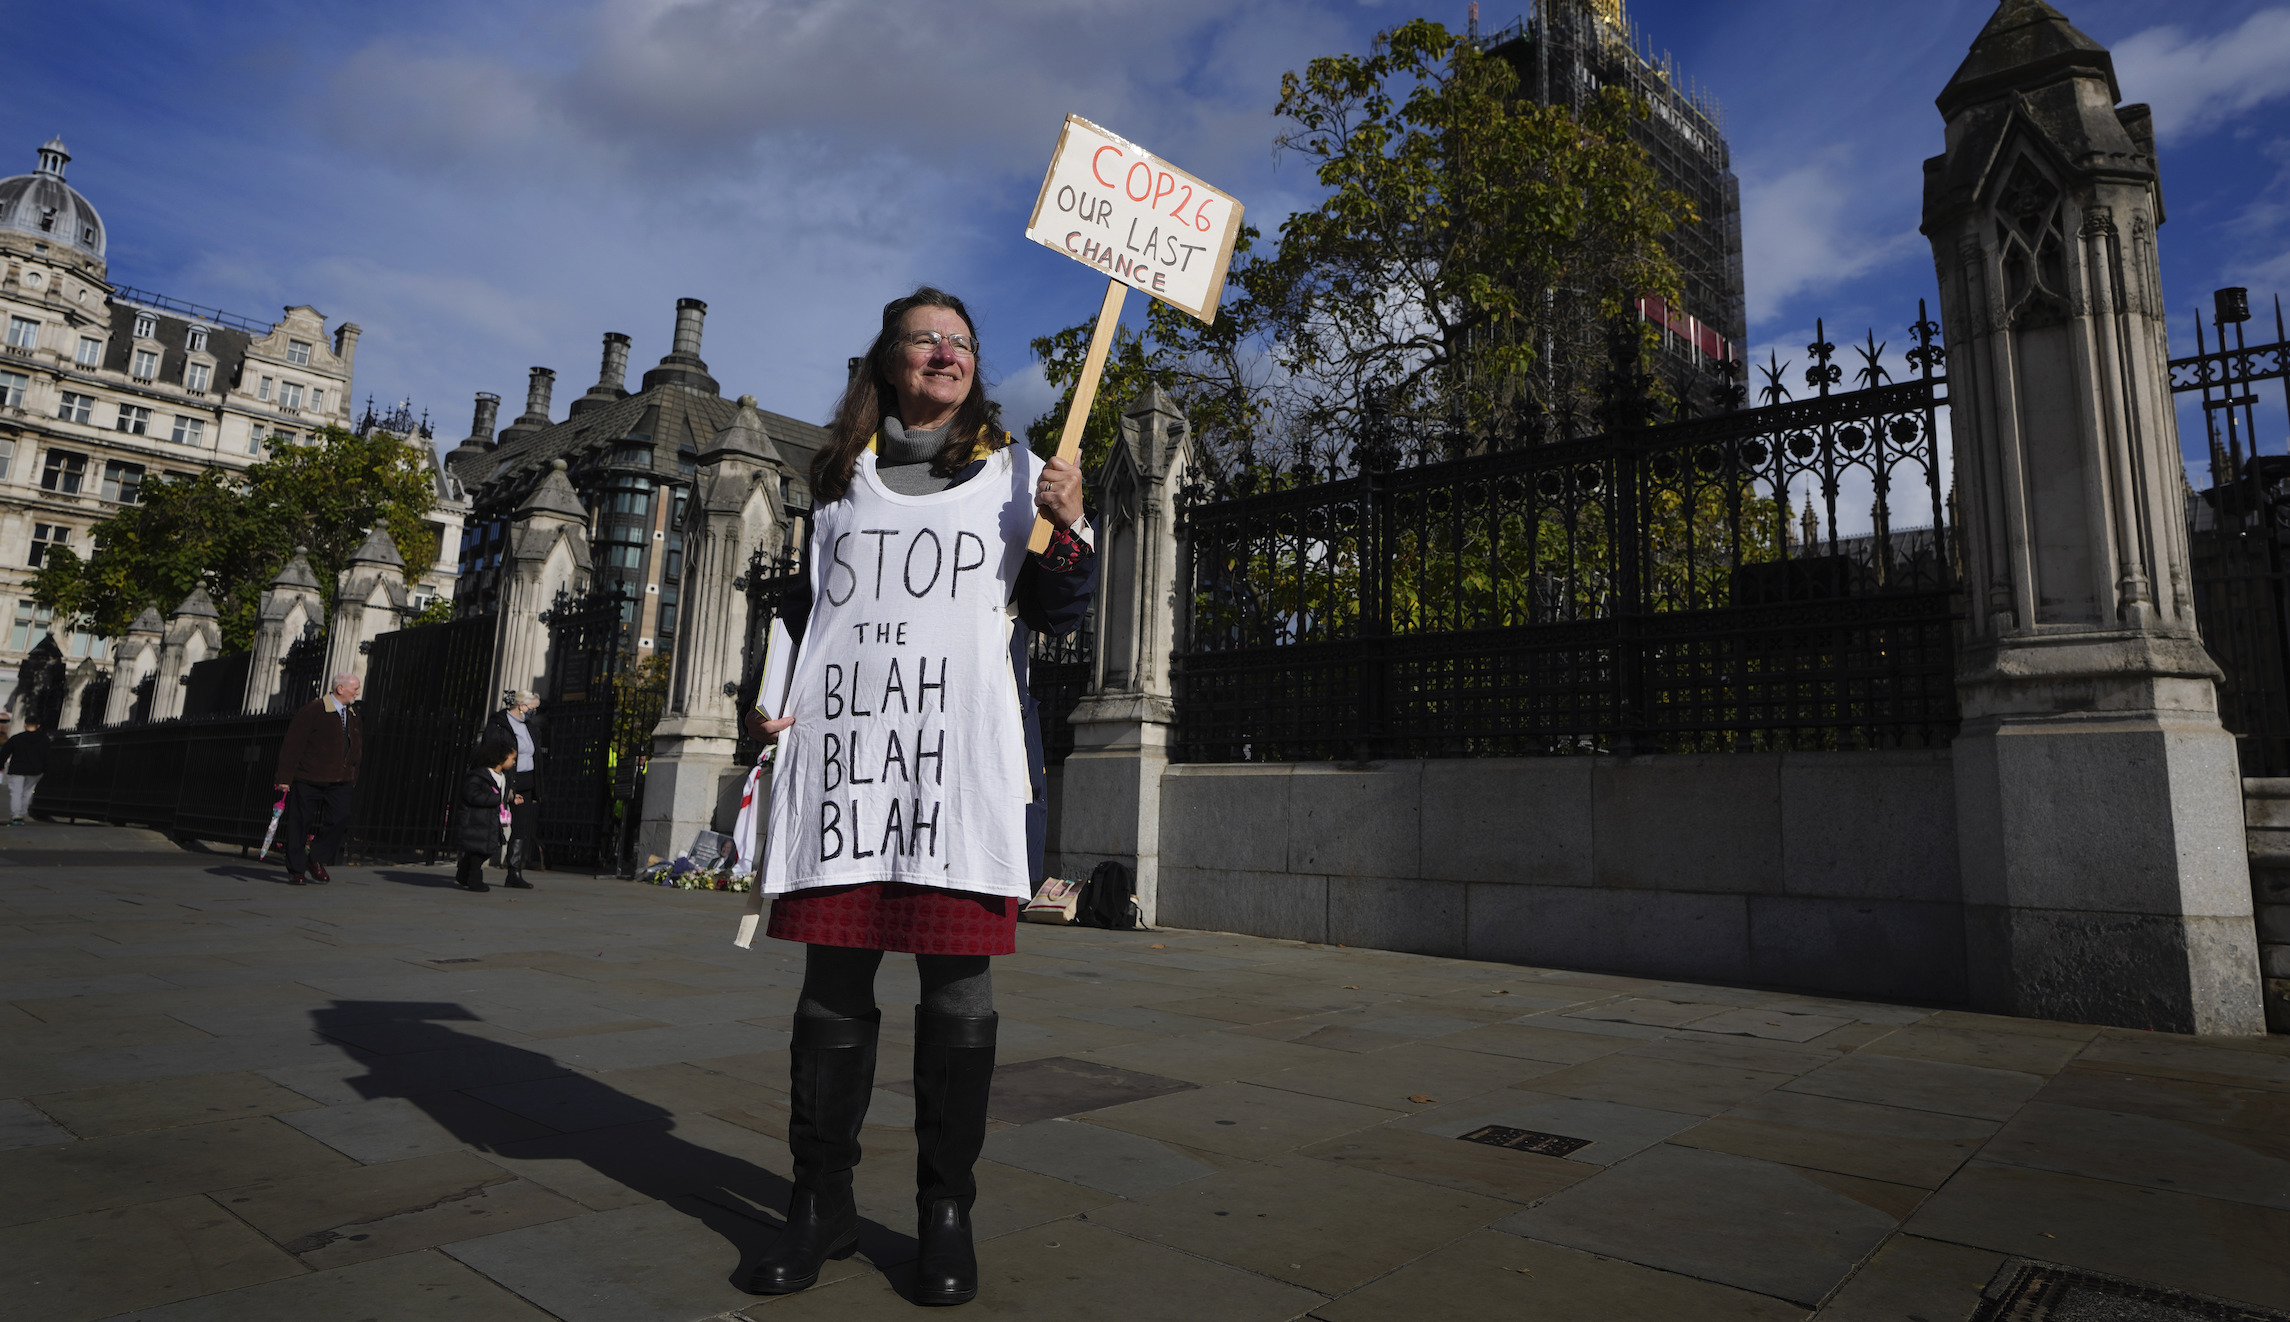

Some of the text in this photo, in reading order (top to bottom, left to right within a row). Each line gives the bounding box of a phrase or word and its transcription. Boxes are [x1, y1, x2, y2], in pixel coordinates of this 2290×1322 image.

[1092, 145, 1214, 232] COP26
[1057, 184, 1207, 272] OUR LAST
[1065, 231, 1166, 293] CHANCE
[826, 527, 986, 607] STOP
[853, 621, 908, 645] THE
[825, 656, 947, 720] BLAH
[823, 729, 945, 792] BLAH
[820, 797, 941, 863] BLAH
